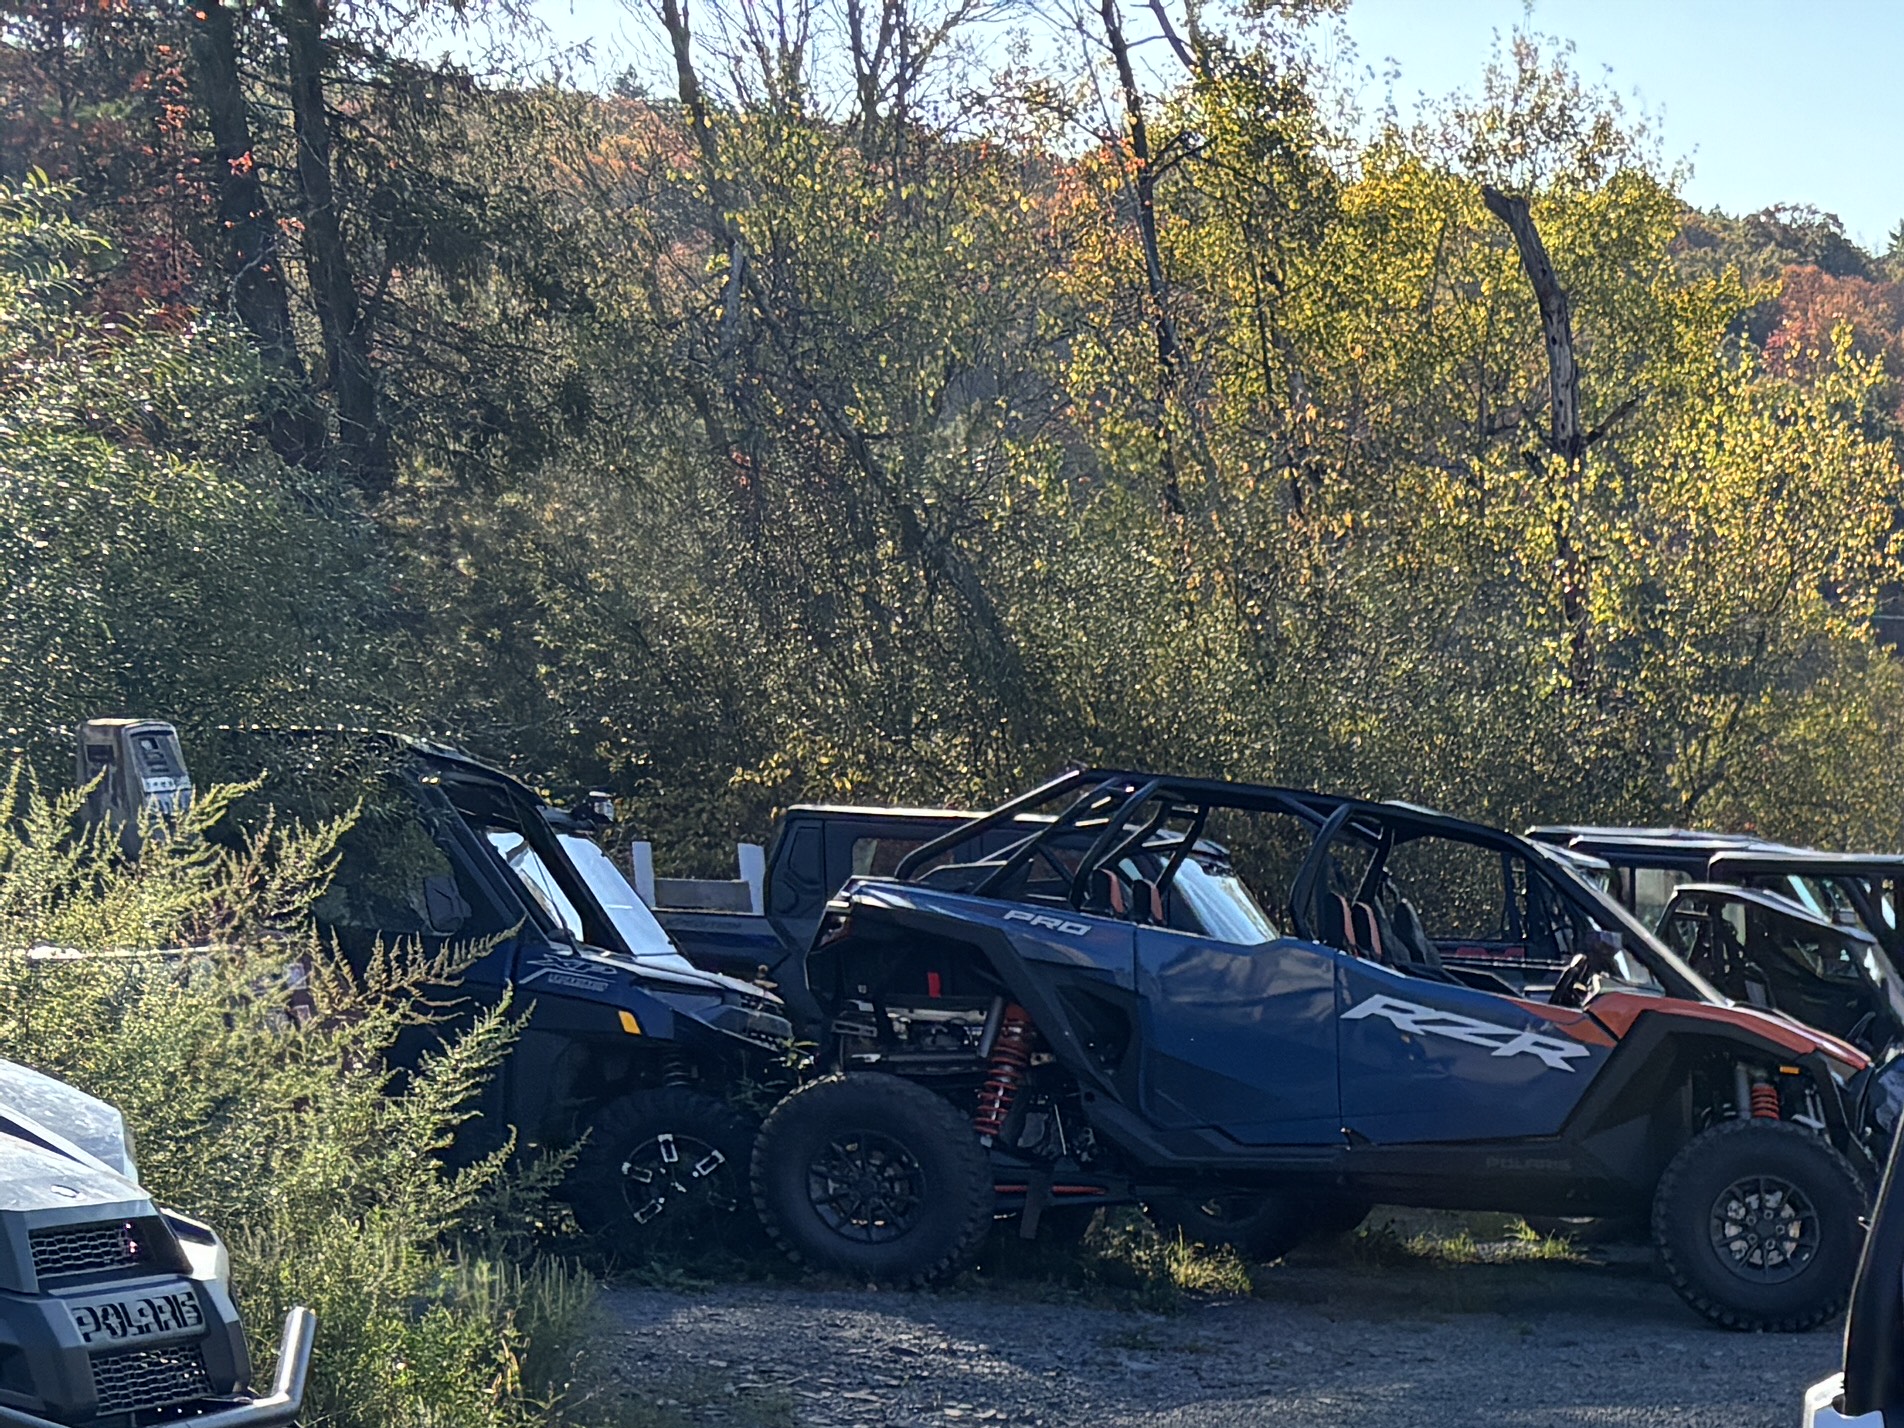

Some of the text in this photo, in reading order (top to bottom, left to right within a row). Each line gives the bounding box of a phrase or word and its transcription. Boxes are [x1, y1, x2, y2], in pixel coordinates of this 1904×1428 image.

[1003, 909, 1092, 936] PRO
[1340, 994, 1590, 1072] RZR
[71, 1292, 203, 1342] POLARIS
